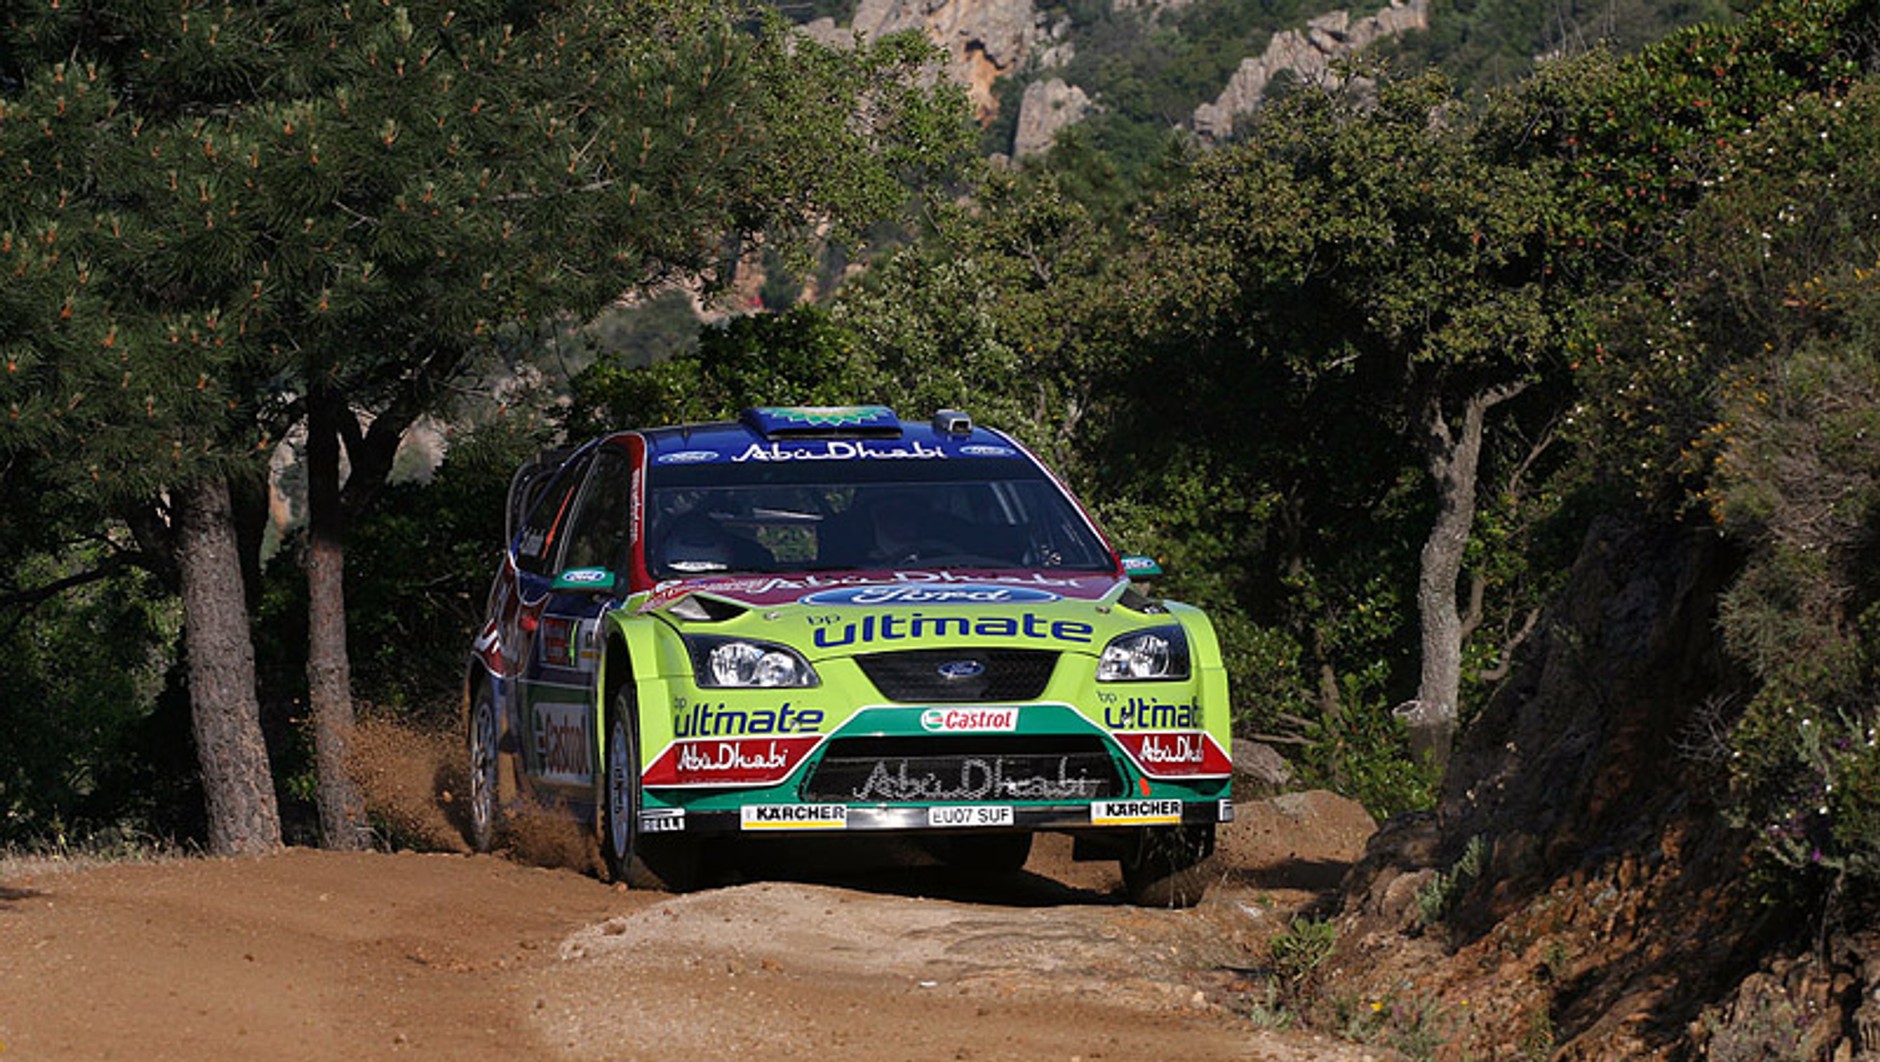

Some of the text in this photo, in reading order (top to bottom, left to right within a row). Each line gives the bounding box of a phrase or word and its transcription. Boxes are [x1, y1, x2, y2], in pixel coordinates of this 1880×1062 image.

[849, 587, 1012, 604] Ford
[813, 613, 1094, 649] ultimate
[673, 703, 824, 737] ultimate
[945, 709, 1012, 730] Castrol
[933, 809, 1010, 825] EU07 SUF
